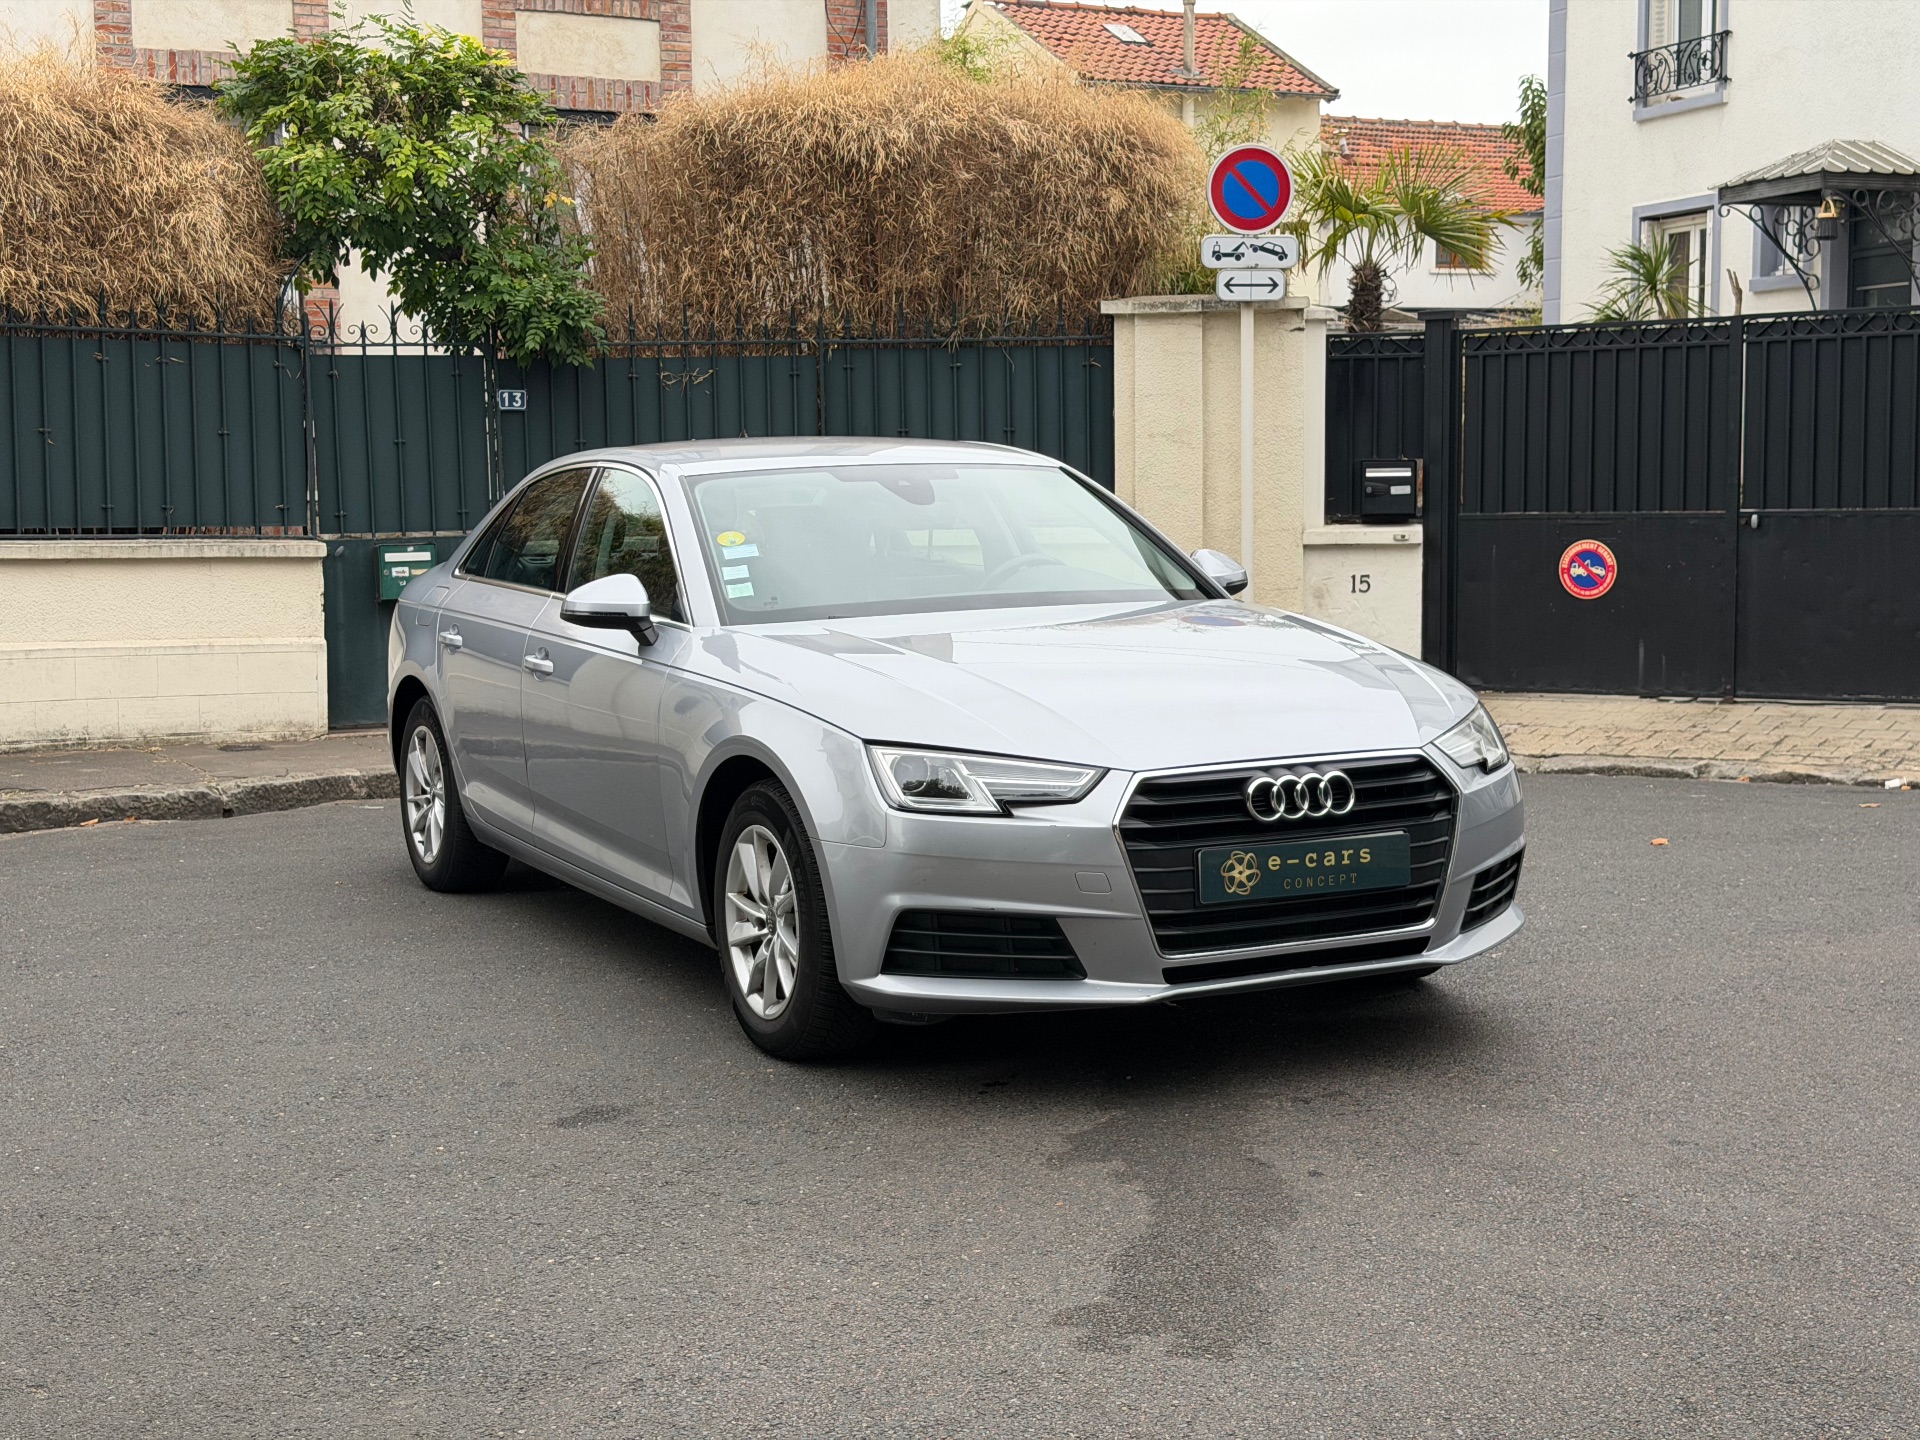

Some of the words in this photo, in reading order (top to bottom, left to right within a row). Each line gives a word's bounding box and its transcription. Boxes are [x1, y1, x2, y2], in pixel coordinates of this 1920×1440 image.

[502, 392, 522, 407] 13
[1350, 574, 1371, 594] 15
[1267, 847, 1372, 871] e-cars
[1283, 873, 1359, 890] CONCEPT
